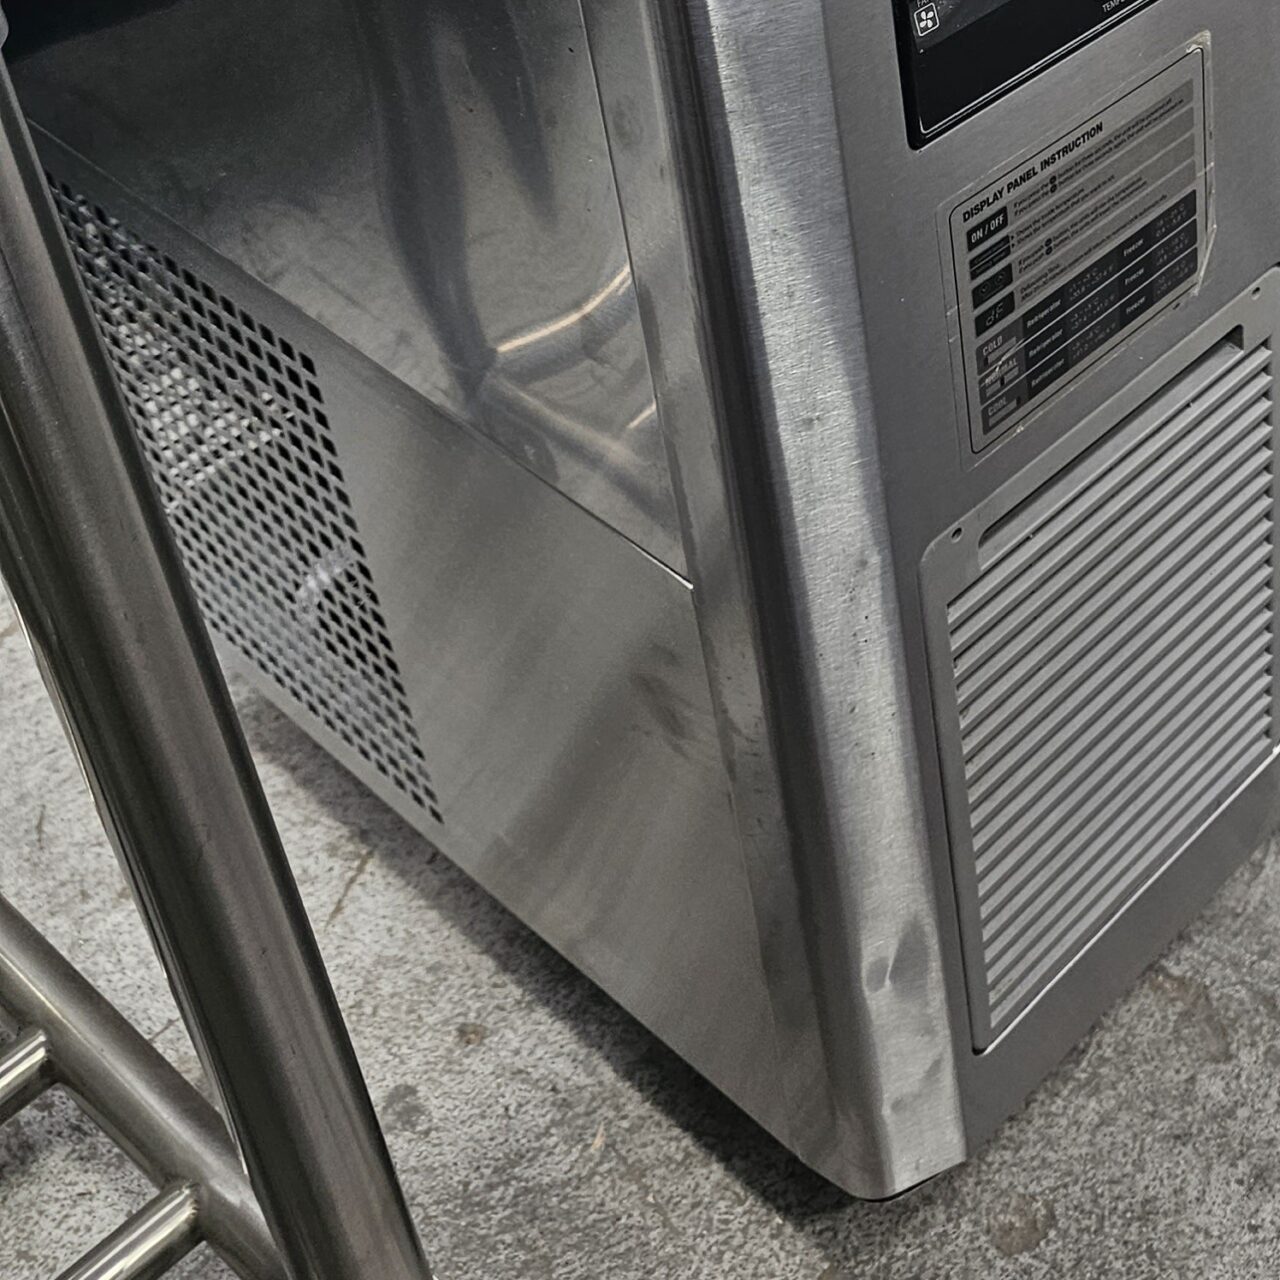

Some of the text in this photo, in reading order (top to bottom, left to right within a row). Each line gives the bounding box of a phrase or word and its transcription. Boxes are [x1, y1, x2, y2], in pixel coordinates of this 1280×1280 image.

[963, 190, 1004, 223] DISPLAY
[1006, 168, 1038, 194] PANEL
[1040, 122, 1103, 177] INSTRUCTION
[971, 231, 983, 244] ON
[990, 215, 1004, 231] OFF
[982, 336, 1003, 356] COLD
